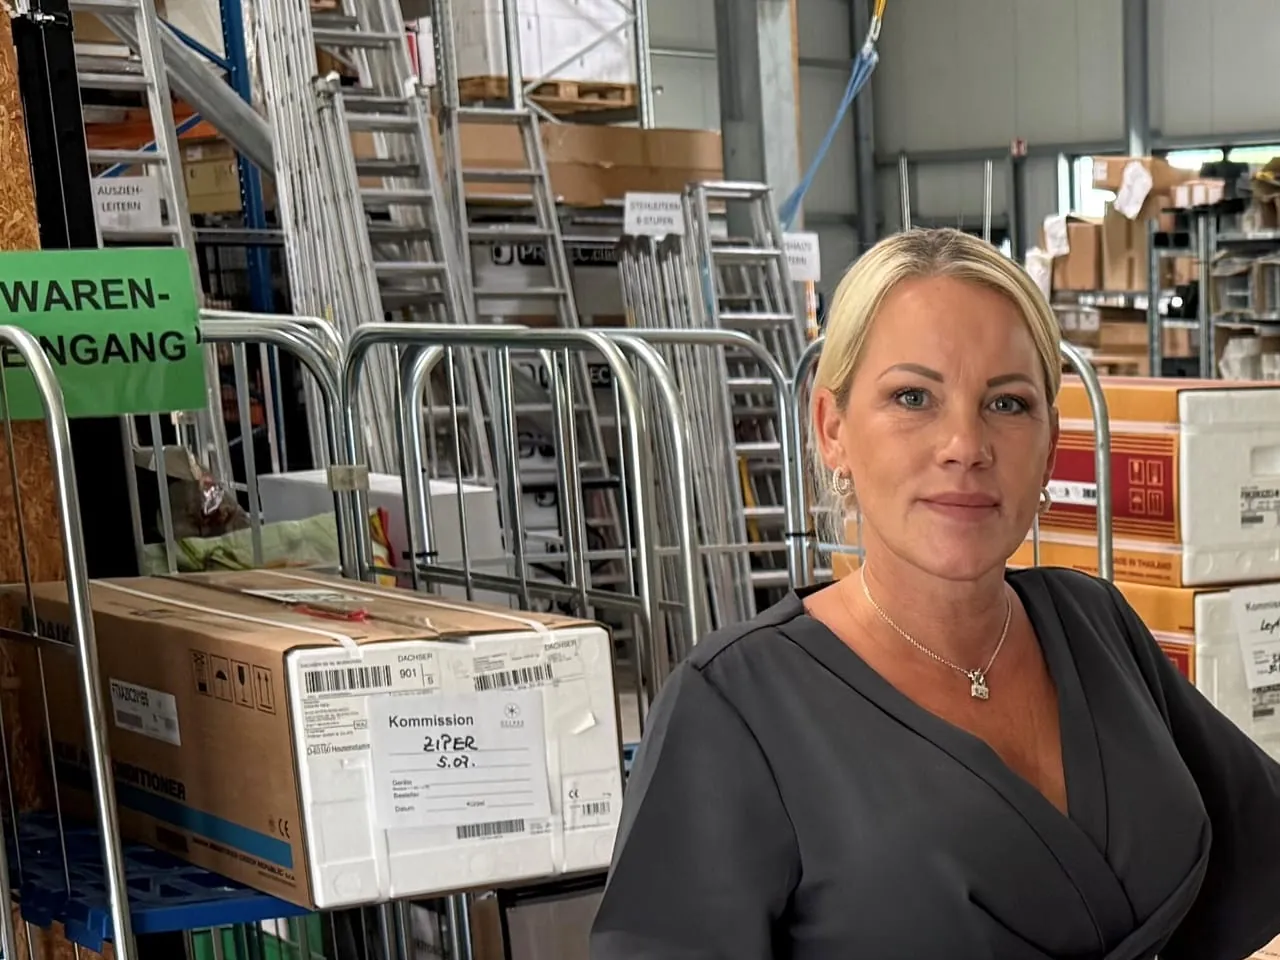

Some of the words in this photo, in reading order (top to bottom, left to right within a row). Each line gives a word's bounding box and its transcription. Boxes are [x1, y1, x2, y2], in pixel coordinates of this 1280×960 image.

[102, 201, 141, 212] LEITERN
[0, 278, 170, 313] WAREN-
[3, 331, 187, 368] ENGANG
[398, 652, 433, 663] DACHSER
[400, 668, 416, 679] 901
[388, 713, 474, 728] Kommission
